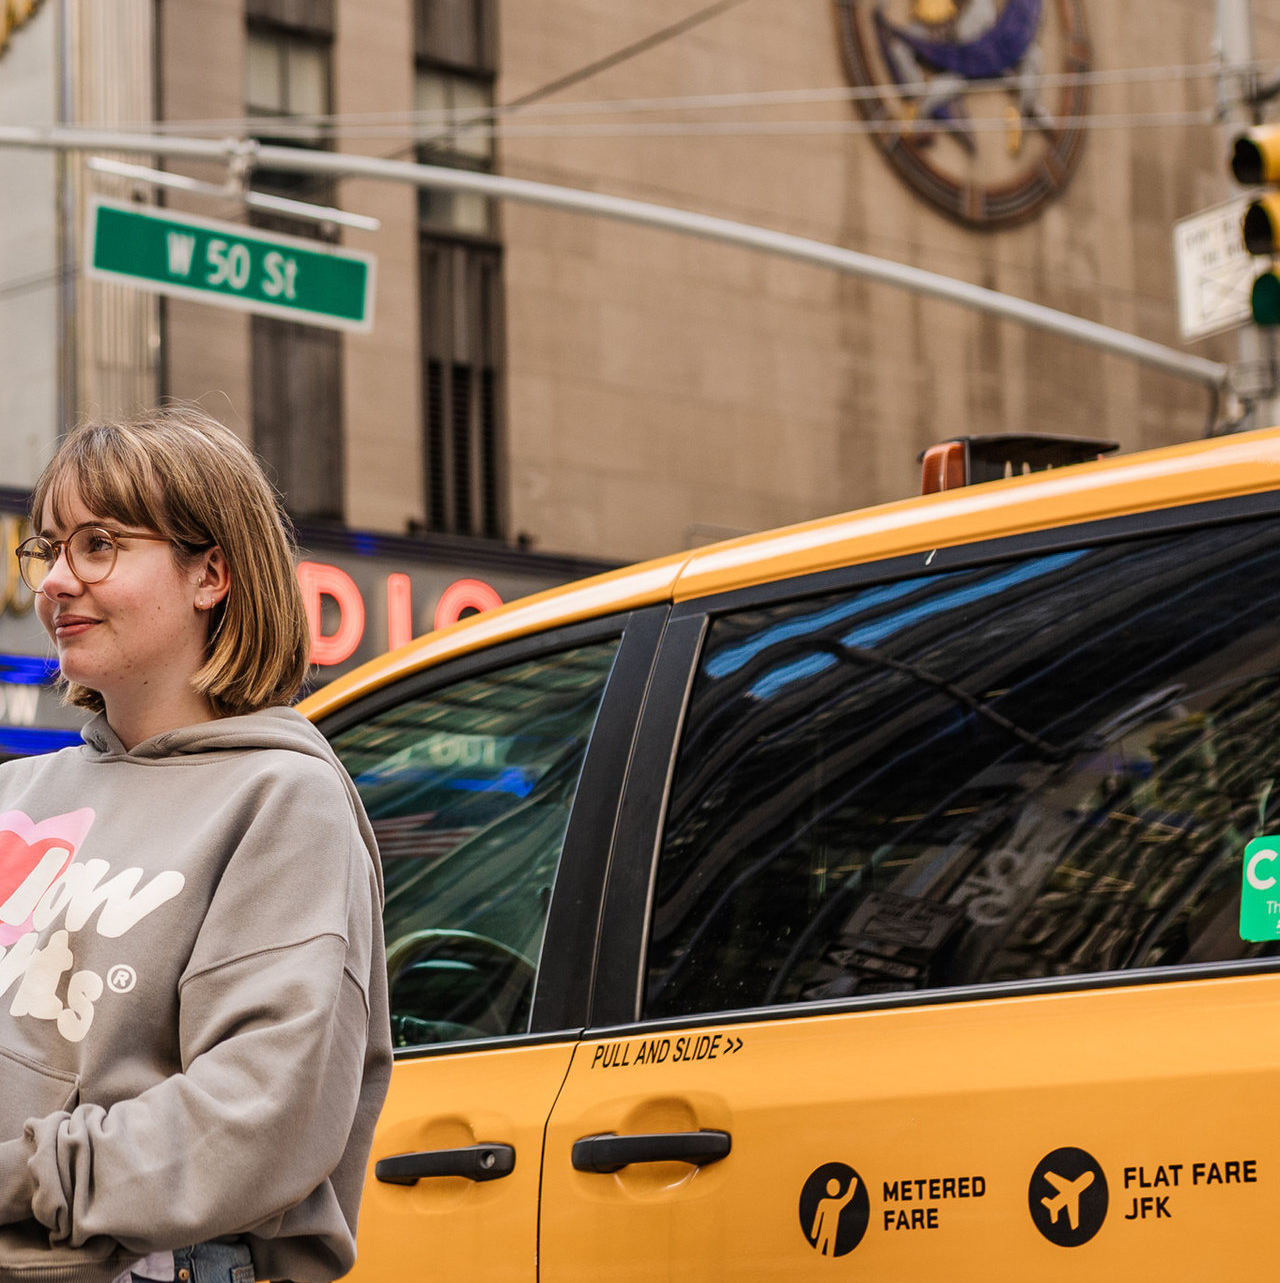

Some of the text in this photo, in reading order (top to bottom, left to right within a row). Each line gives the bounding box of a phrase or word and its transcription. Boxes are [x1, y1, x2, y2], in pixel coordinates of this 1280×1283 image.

[166, 230, 298, 300] W 50 St
[591, 1034, 723, 1069] PULL AND SLIDE
[1124, 1160, 1258, 1189] FLAT FARE
[883, 1176, 986, 1202] METERED
[884, 1208, 939, 1231] FARE
[1124, 1196, 1172, 1220] JFK
